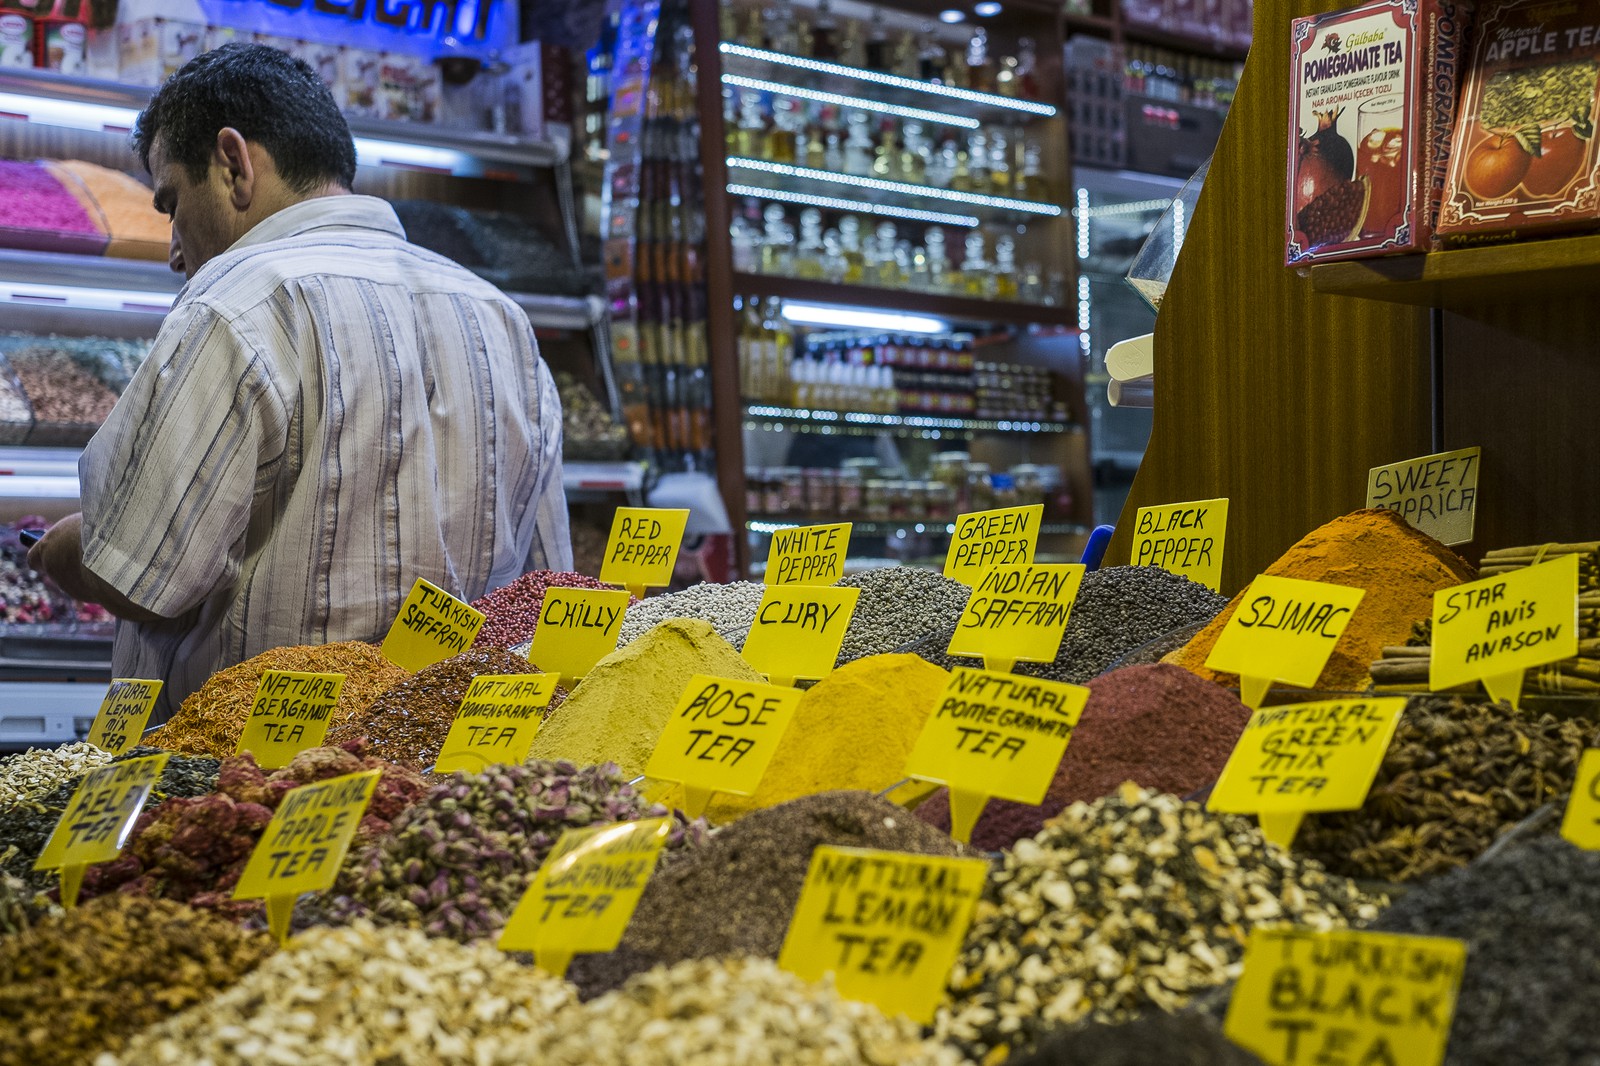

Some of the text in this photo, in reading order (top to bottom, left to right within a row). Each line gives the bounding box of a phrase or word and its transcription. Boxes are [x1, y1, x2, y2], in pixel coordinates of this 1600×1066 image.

[1346, 27, 1385, 52] Gülbaba
[1485, 32, 1558, 62] APPLE
[1496, 22, 1545, 40] Natural
[1304, 40, 1403, 85] POMEGRANATE TEA
[1312, 98, 1325, 108] NAR
[1325, 93, 1353, 105] AROMALI
[1375, 84, 1393, 95] TOZU
[1430, 4, 1456, 191] POMEGRANATE
[1373, 454, 1478, 499] SWEET
[619, 517, 661, 540] RED
[959, 512, 1029, 540] GREEN
[1137, 508, 1207, 535] BLACK
[611, 542, 671, 567] PEPPER
[776, 528, 841, 557] WHITE
[953, 539, 1028, 569] PEPPER
[1138, 537, 1213, 568] PEPPER
[776, 552, 837, 585] PEPPER
[977, 566, 1071, 600] INDIAN
[420, 584, 480, 632] TURKISH
[543, 598, 621, 637] CHILLY
[760, 601, 841, 633] CURY
[962, 597, 1071, 629] SAFFRAN
[1238, 595, 1350, 638] SUMAC
[1438, 582, 1507, 624] STAR
[1486, 600, 1536, 634] ANIS
[402, 604, 468, 653] SAFFRAN
[1465, 624, 1562, 664] ANASON
[104, 682, 152, 701] NATURAL
[261, 673, 336, 699] NATURAL
[467, 681, 542, 699] NATURAL
[947, 671, 1070, 717] NATURAL
[106, 700, 149, 717] LEMON
[681, 683, 781, 726] ROSE
[1247, 703, 1383, 727] NATURAL
[101, 732, 126, 752] TEA
[264, 723, 304, 743] TEA
[468, 726, 517, 748] TEA
[685, 730, 755, 767] TEA
[956, 726, 1027, 760] TEA
[1261, 726, 1379, 753] GREEN
[277, 775, 374, 818] NATURAL
[1250, 775, 1329, 797] TEA
[67, 816, 121, 848] TEA
[270, 811, 349, 847] APPLE
[268, 848, 329, 878] TEA
[814, 856, 970, 898] NATURAL
[540, 893, 613, 923] TEA
[822, 887, 957, 937] LEMON
[835, 931, 926, 976] TEA
[1268, 967, 1441, 1028] BLACK
[1268, 1018, 1398, 1066] TEA
